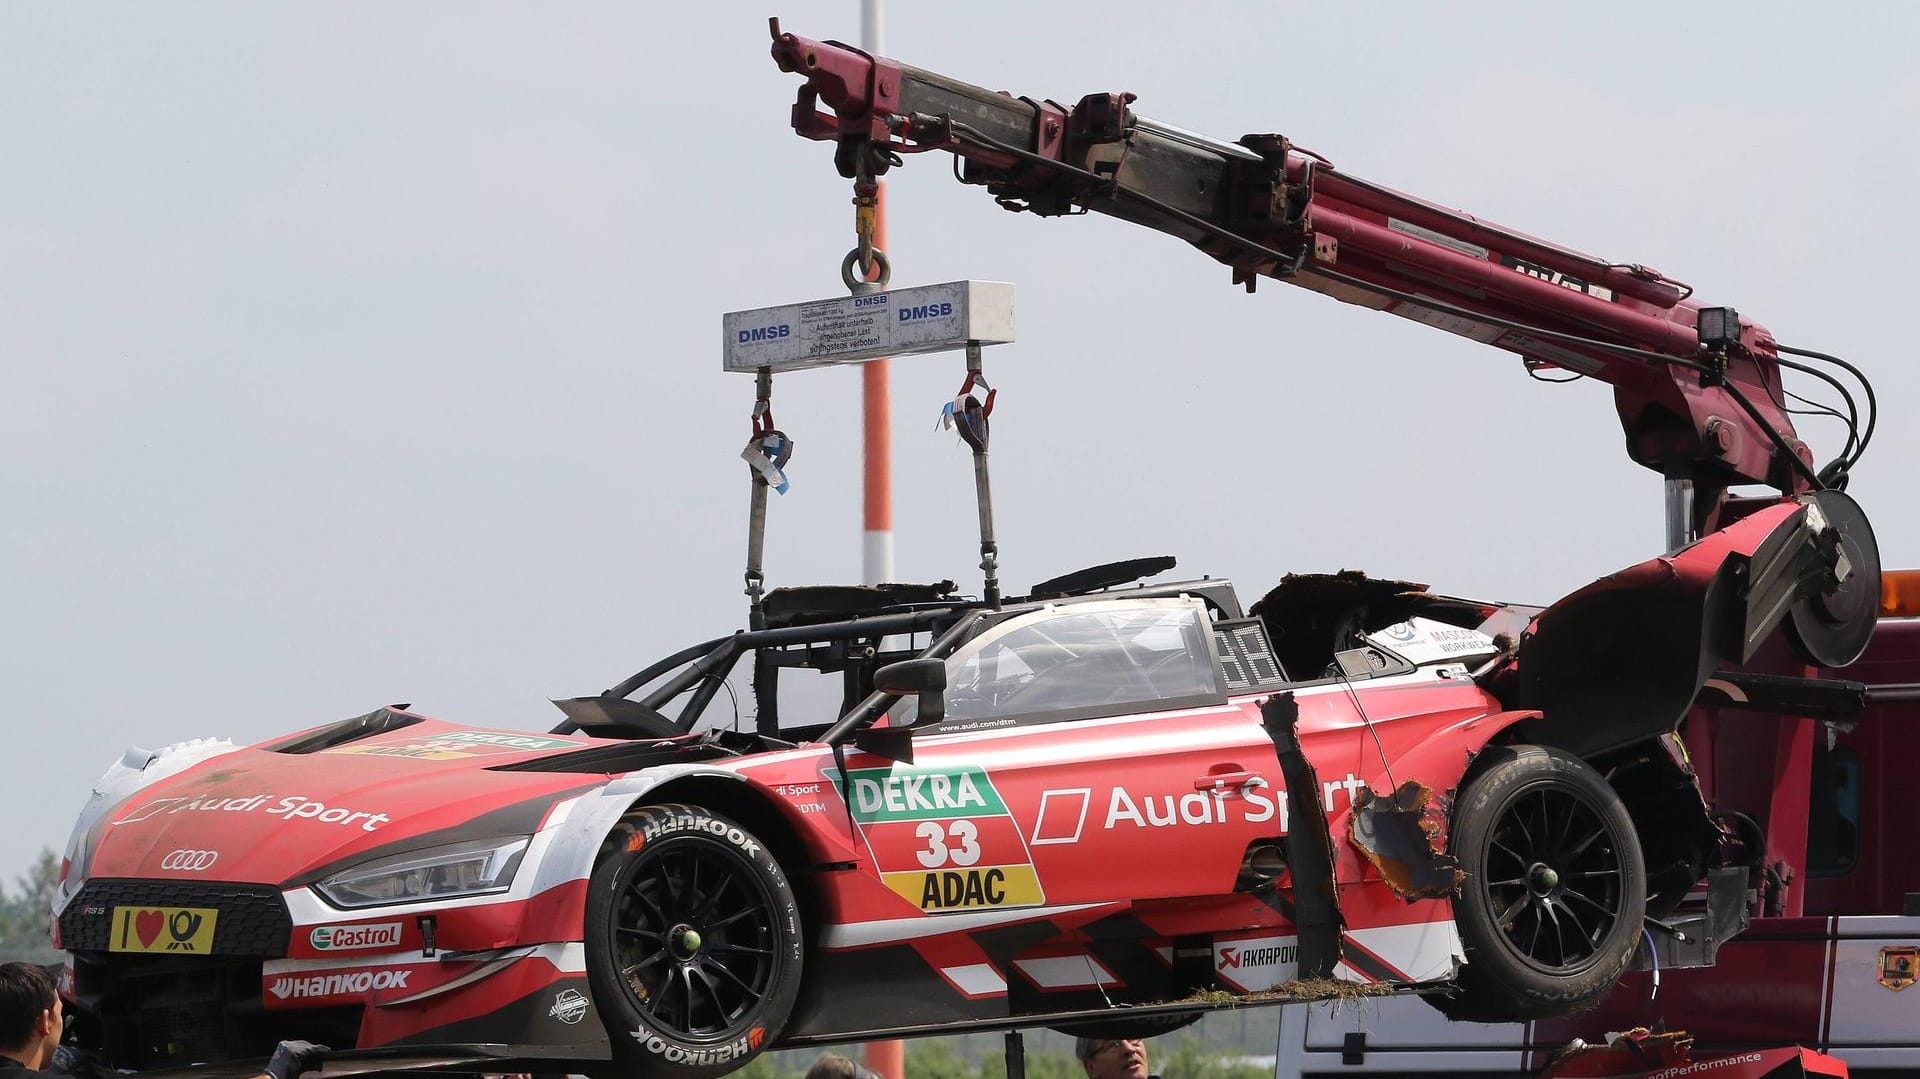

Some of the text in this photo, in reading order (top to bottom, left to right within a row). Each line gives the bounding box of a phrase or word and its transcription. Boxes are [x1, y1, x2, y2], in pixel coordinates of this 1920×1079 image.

[855, 296, 888, 307] DMSB
[898, 302, 953, 321] DMSB
[738, 324, 790, 344] DMSB
[1429, 631, 1481, 642] MASCOT
[939, 718, 1017, 733] www.audi.com/dtm
[788, 784, 820, 796] Sport
[855, 772, 987, 814] DEKRA
[170, 794, 391, 832] Audi Sport
[794, 803, 826, 814] DTM
[1104, 773, 1366, 833] Audi Srt
[915, 820, 981, 868] 33
[921, 869, 1006, 909] ADAC
[332, 926, 397, 947] Castrol
[1243, 945, 1299, 968] AKRAPOVI
